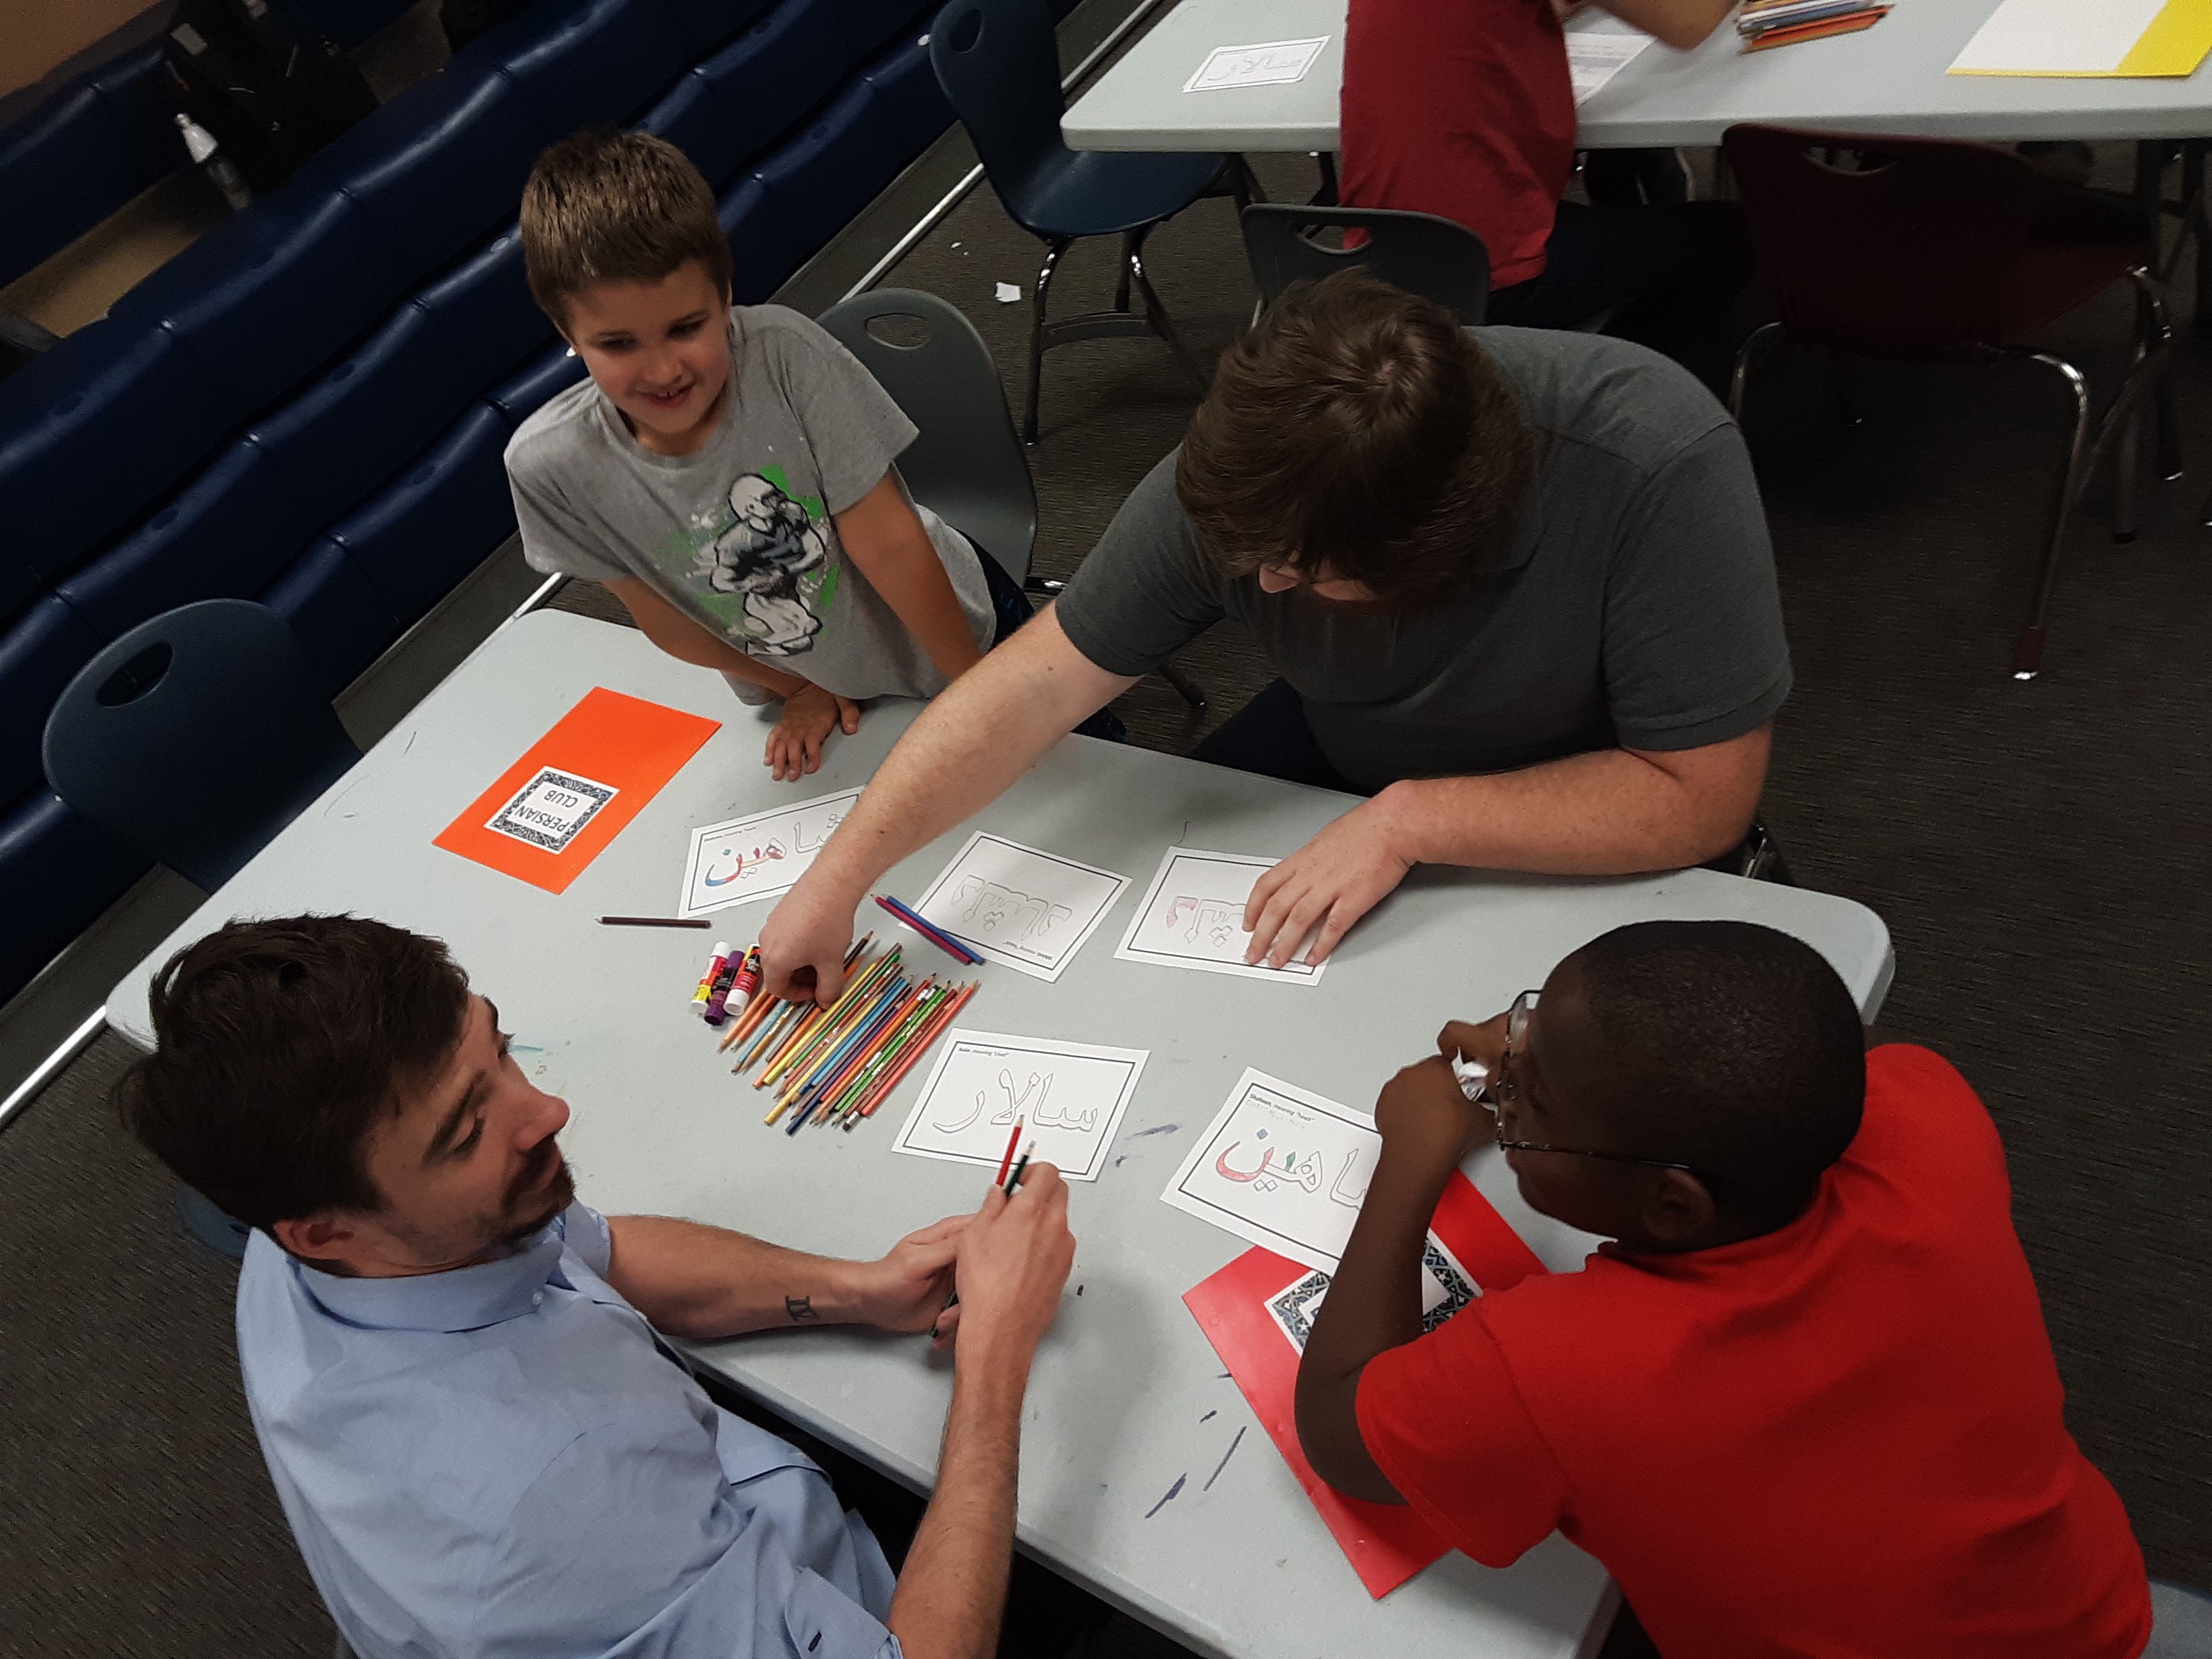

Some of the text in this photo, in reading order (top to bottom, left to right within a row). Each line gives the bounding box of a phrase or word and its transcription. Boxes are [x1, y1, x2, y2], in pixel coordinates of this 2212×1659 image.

[544, 790, 579, 808] CLUB
[514, 805, 571, 832] PERSIAN
[933, 1069, 1098, 1134] سالار
